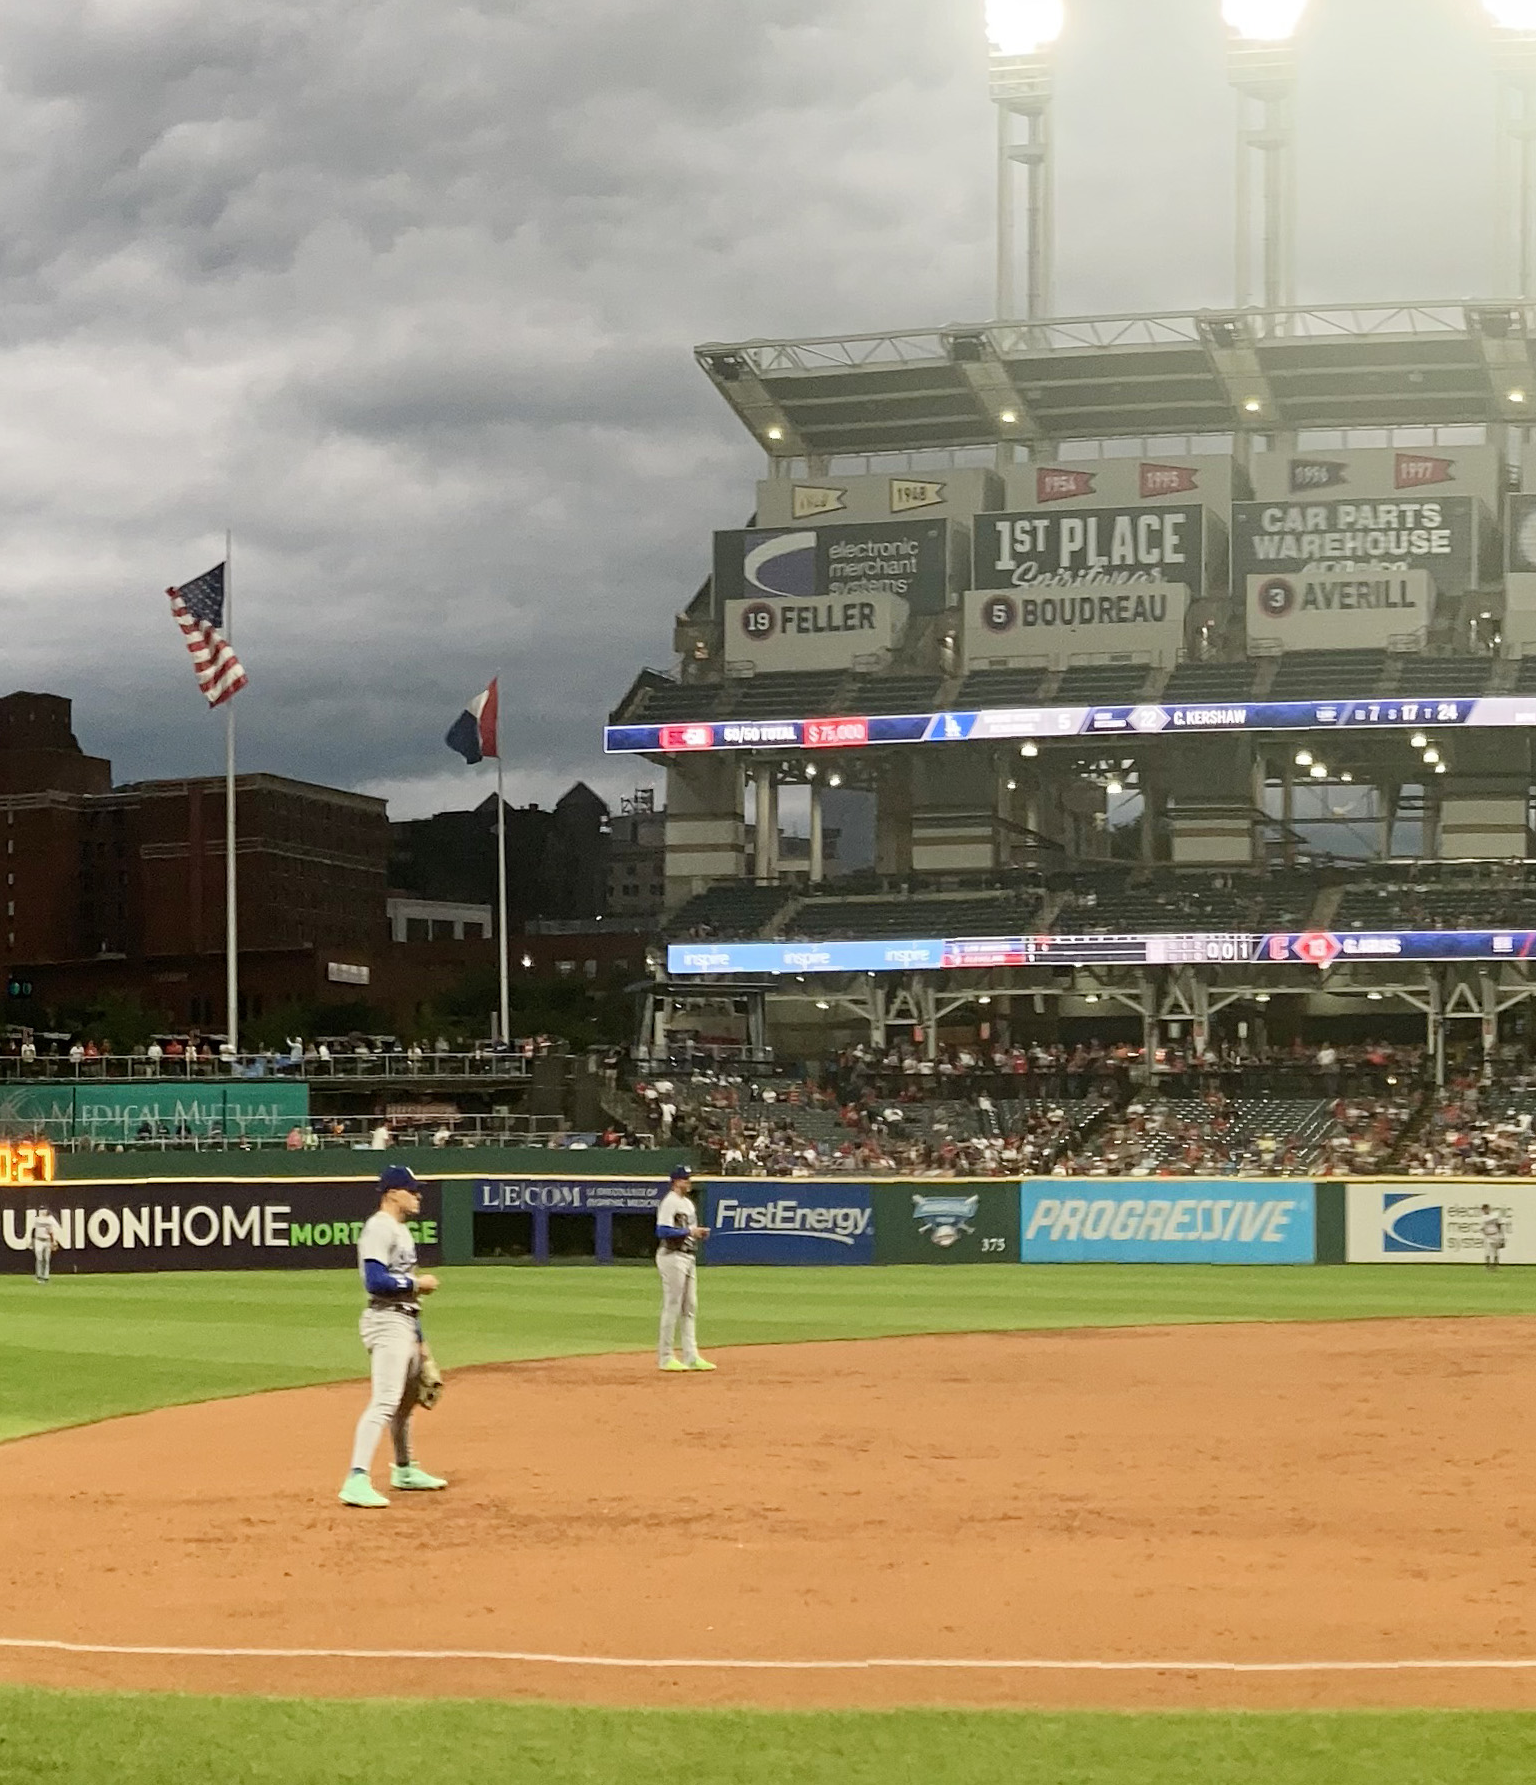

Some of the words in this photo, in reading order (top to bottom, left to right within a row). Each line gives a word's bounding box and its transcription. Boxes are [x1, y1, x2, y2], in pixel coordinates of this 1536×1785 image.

[896, 486, 928, 504] 1948
[1044, 473, 1078, 493] 1954
[1145, 471, 1180, 489] 1995
[1262, 505, 1330, 533] CAR
[1337, 502, 1442, 530] PARTS
[828, 538, 920, 561] electronic
[995, 519, 1050, 571] 1ST
[1059, 513, 1187, 569] PLACE
[1251, 529, 1452, 560] WAREHOUSE
[828, 555, 919, 576] merchant
[1022, 593, 1168, 627] BOUDREAU
[1299, 579, 1416, 612] AVERILL
[780, 601, 876, 635] FELLER
[1186, 708, 1247, 726] KERSHAW
[716, 1199, 871, 1236] FirstEnergy
[1025, 1198, 1295, 1244] PROGRESSIVE
[981, 1238, 1007, 1253] 375
